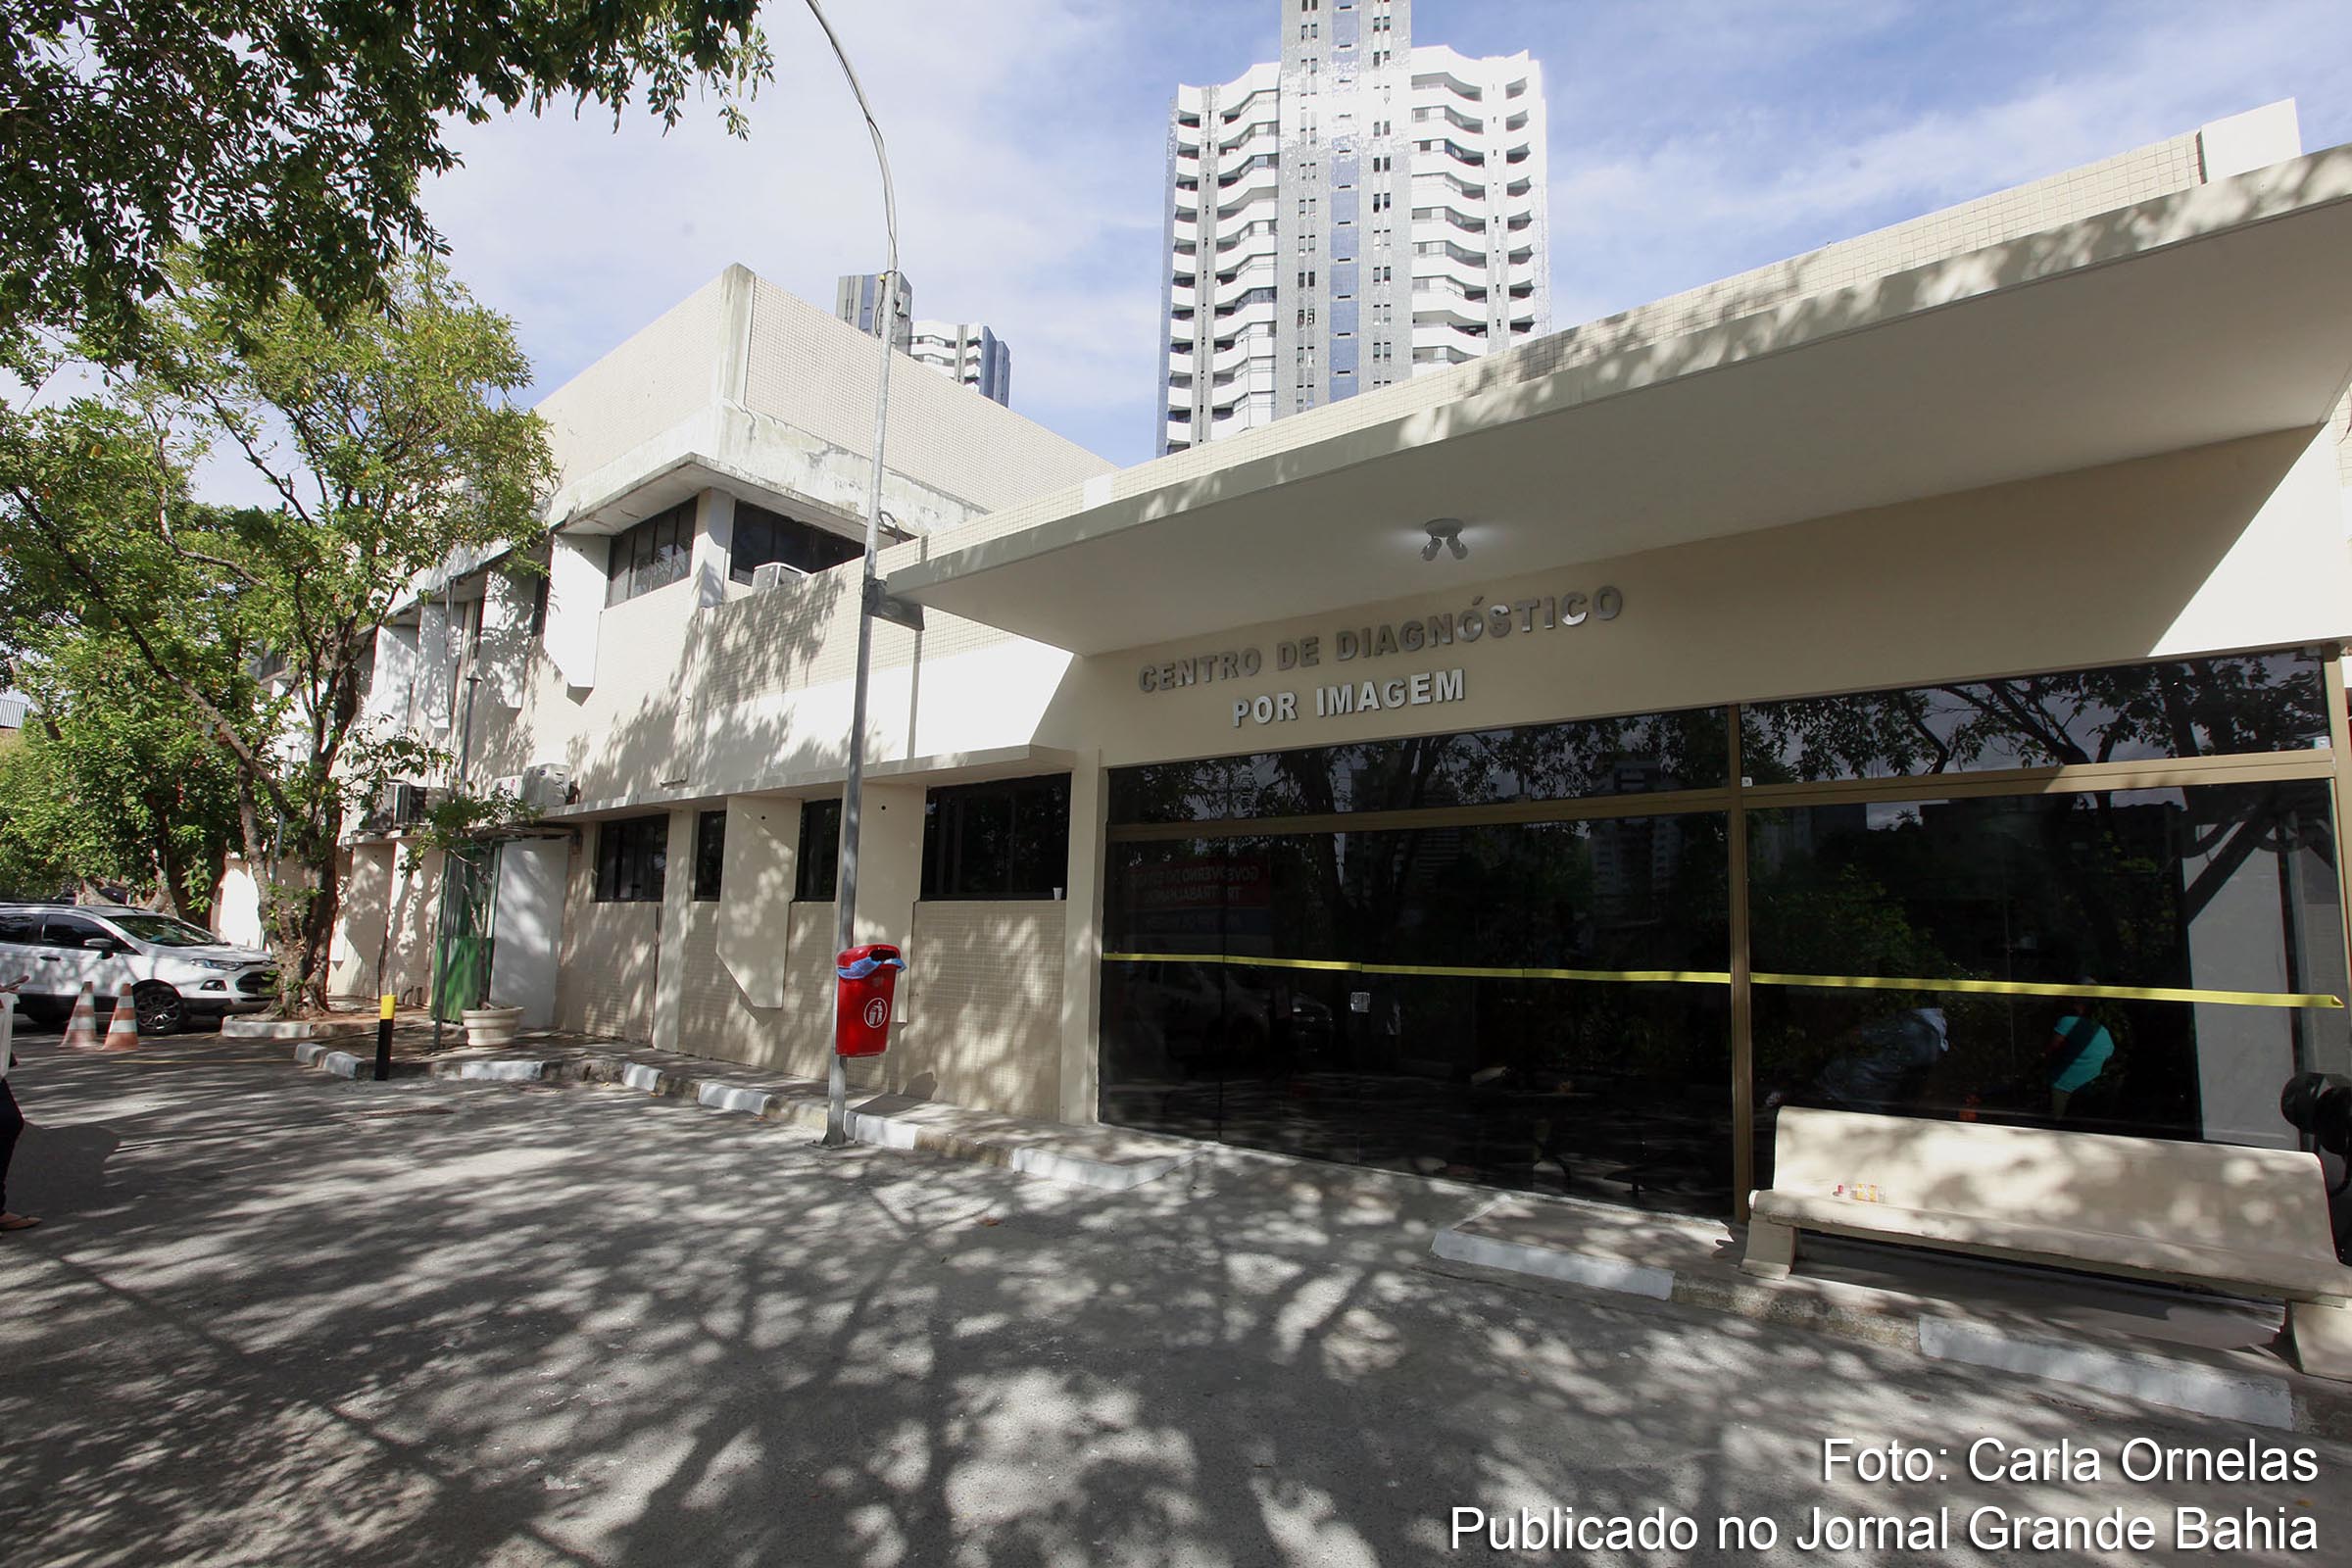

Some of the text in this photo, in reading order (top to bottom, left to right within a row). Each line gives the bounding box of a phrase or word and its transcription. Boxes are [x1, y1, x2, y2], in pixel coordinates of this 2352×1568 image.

[1139, 585, 1623, 692] CENTRO DE DIAGNÓSTICO
[1233, 668, 1465, 727] POR IMAGEM
